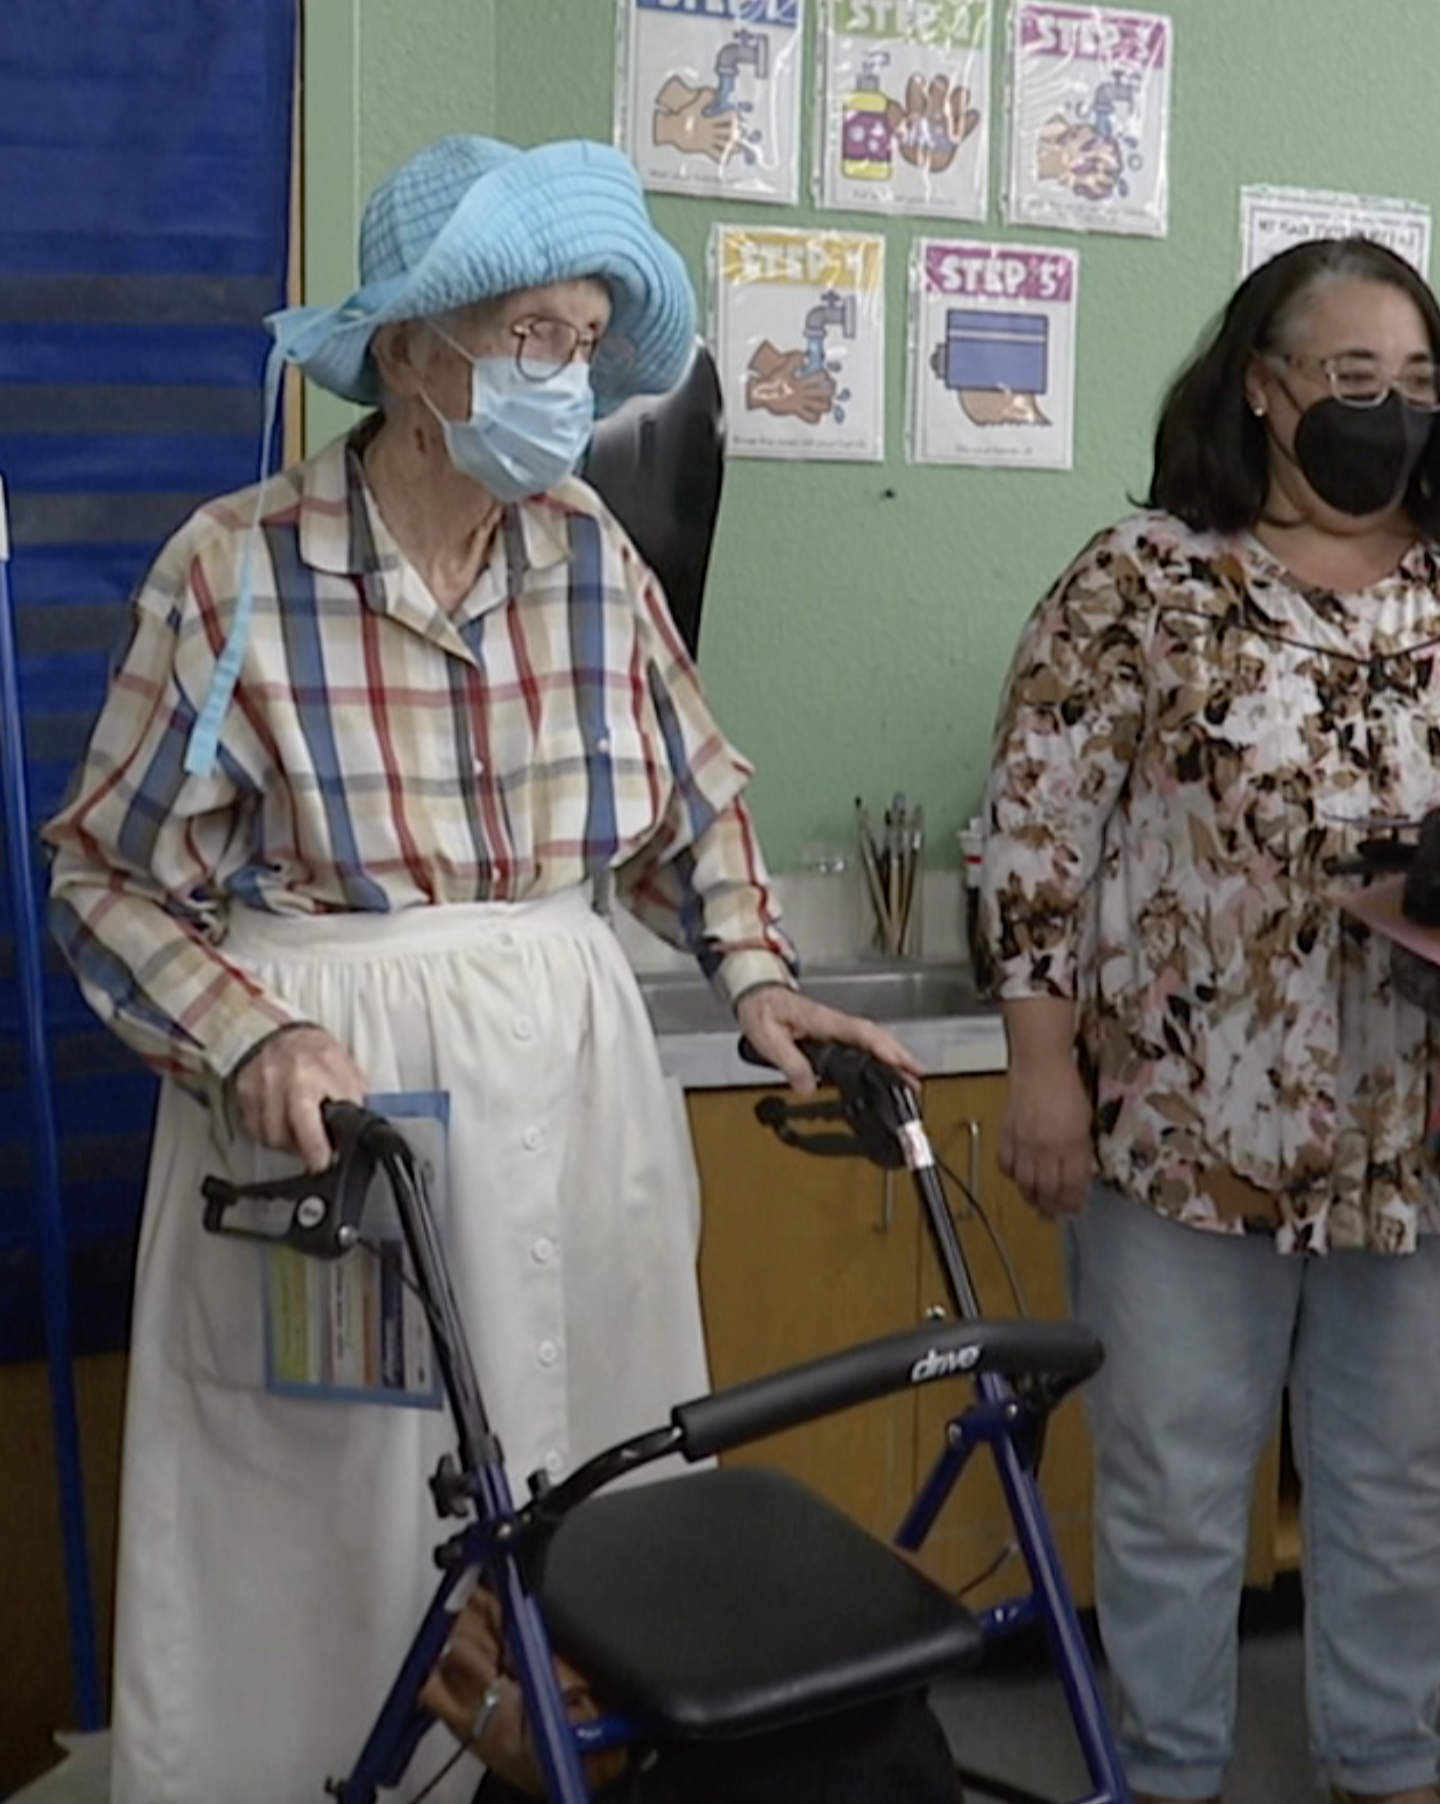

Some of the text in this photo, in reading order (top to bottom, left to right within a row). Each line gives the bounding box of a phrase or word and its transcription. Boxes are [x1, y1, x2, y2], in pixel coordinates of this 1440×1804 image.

[939, 254, 1057, 297] STEP 5
[911, 1345, 981, 1383] drive
